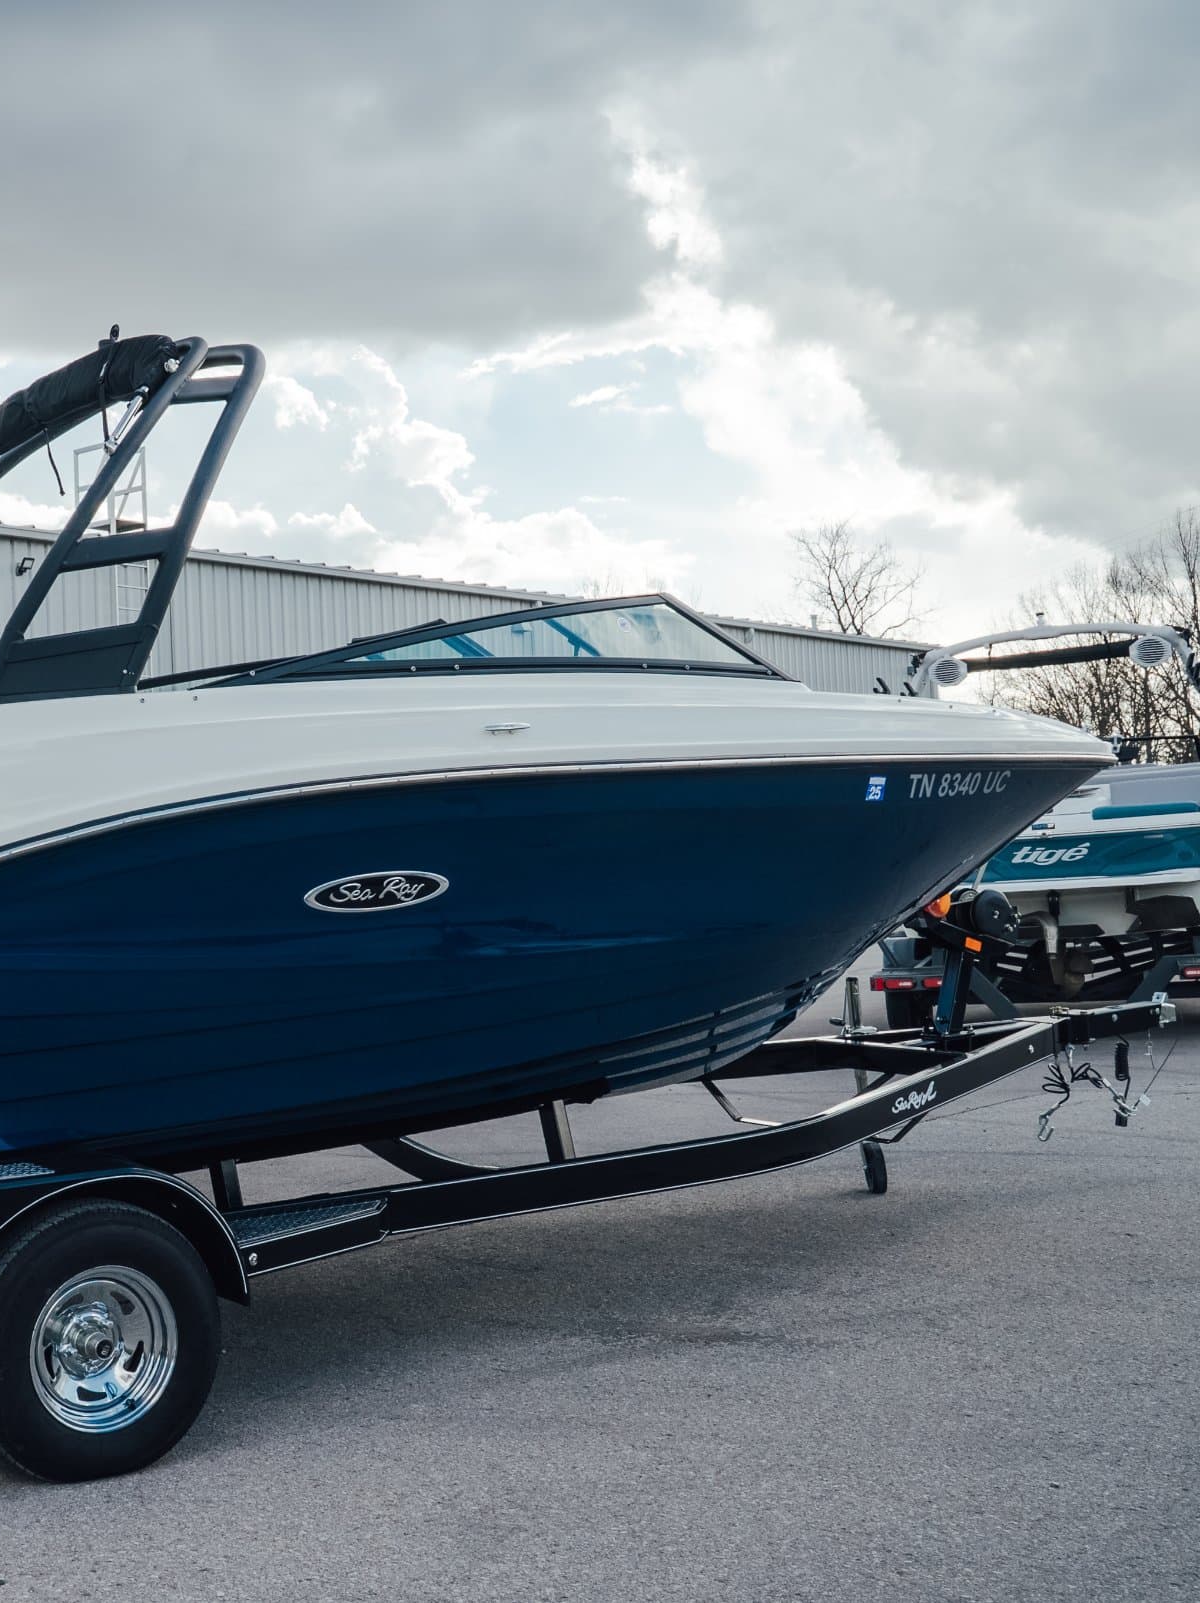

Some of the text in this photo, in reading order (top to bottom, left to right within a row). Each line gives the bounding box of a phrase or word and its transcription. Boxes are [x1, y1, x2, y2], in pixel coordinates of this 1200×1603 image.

[868, 785, 882, 800] 25
[909, 770, 1011, 799] TN 8340 UC
[1011, 842, 1091, 866] tigé
[329, 876, 425, 903] Sea Ray
